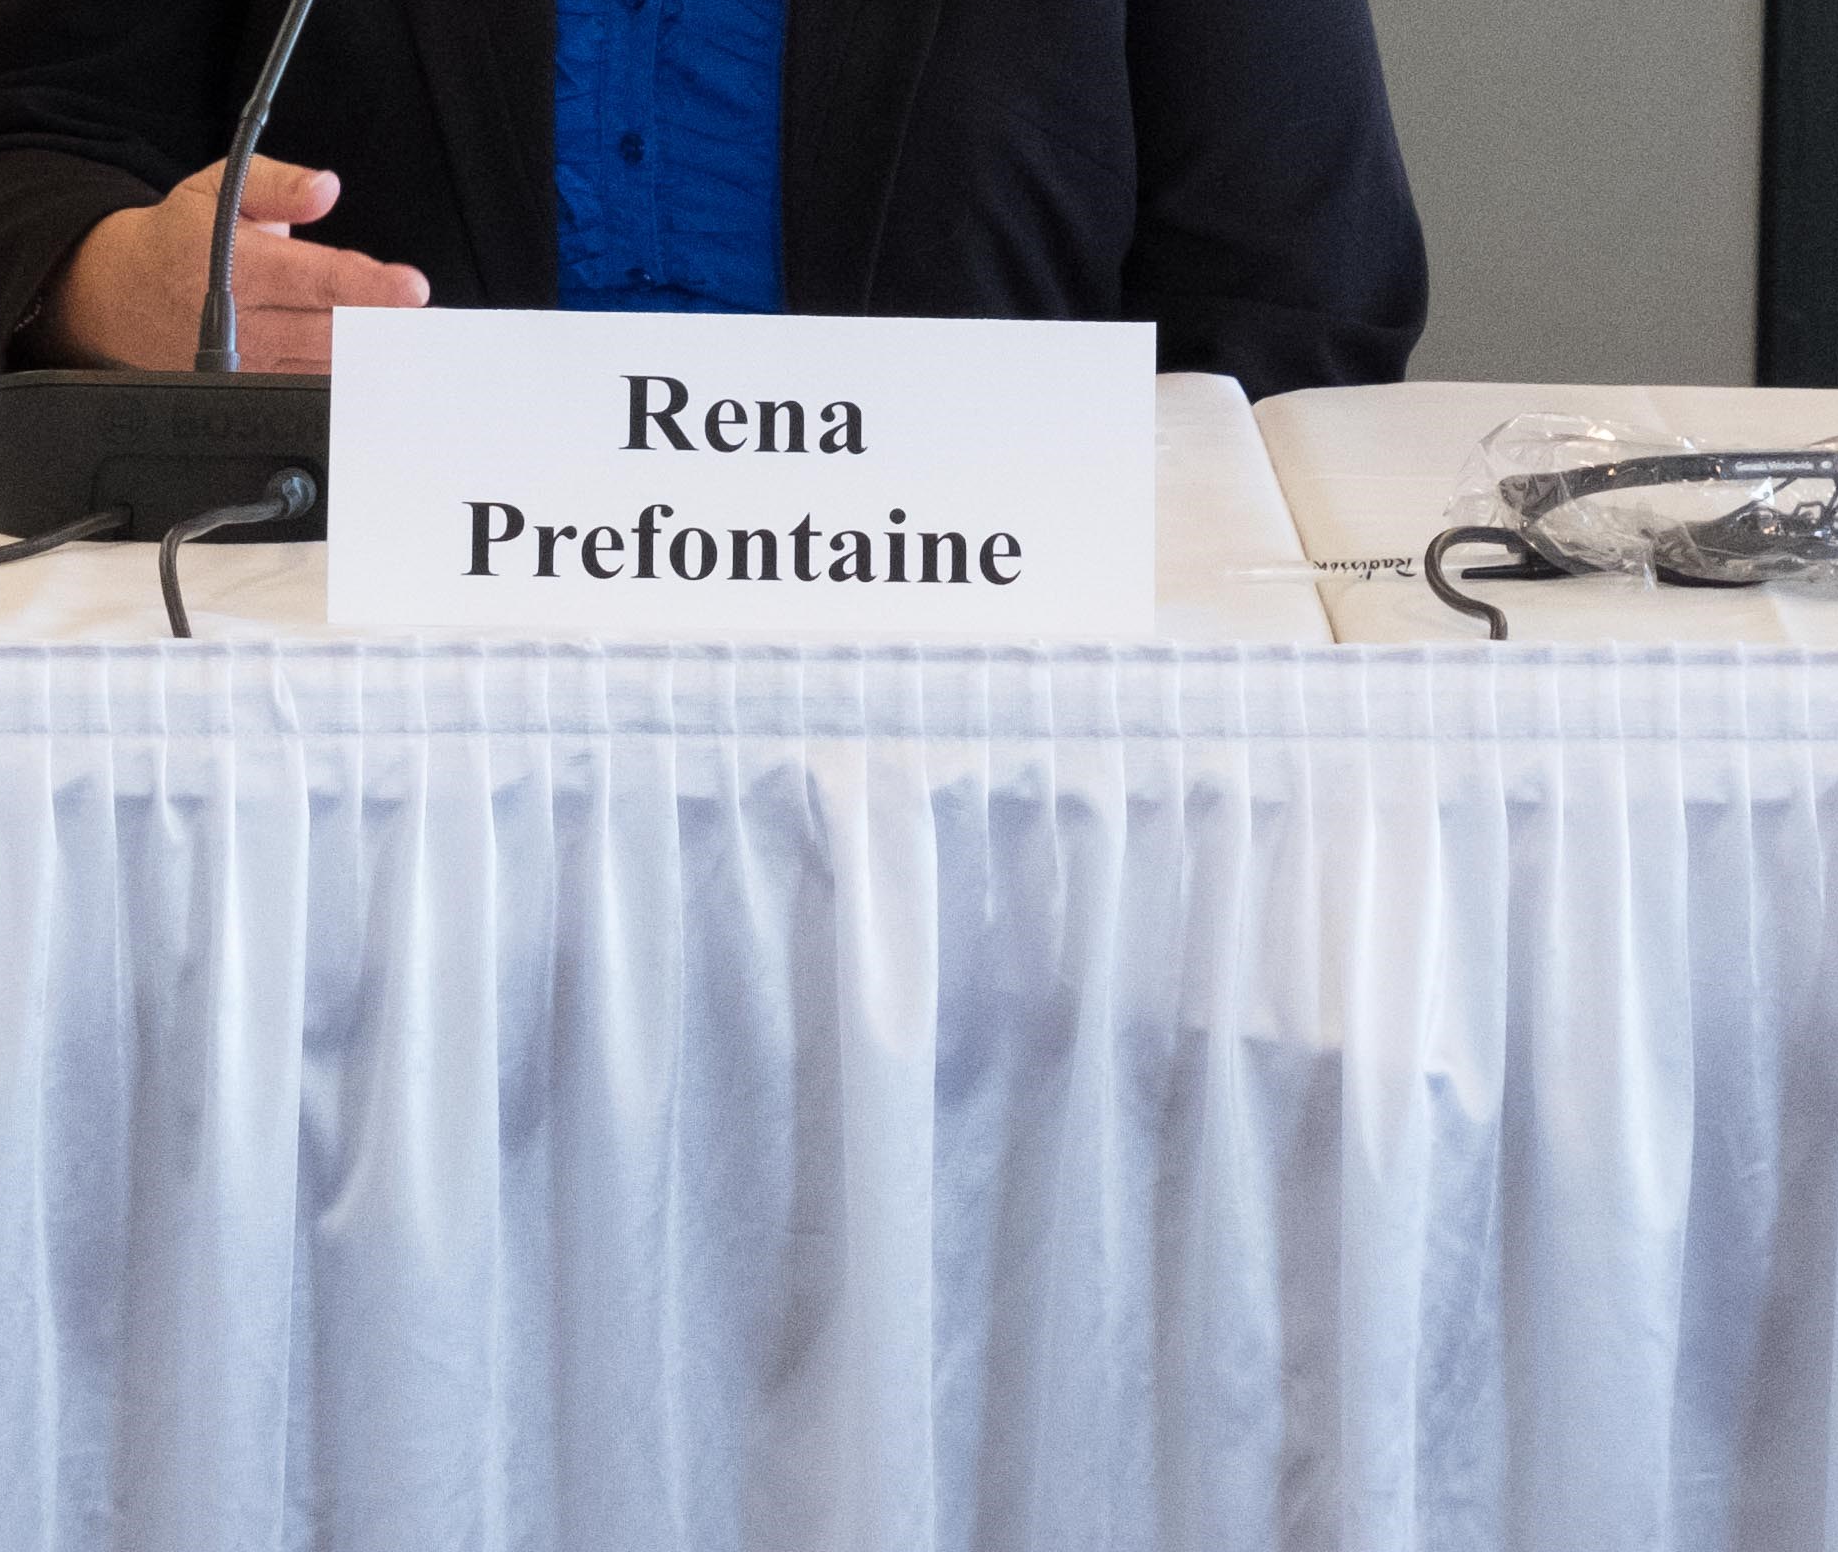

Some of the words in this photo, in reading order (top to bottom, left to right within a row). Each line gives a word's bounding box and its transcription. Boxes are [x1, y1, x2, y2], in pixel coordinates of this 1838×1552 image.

[619, 376, 867, 454] Rena
[463, 502, 1021, 585] Prefontaine
[1313, 557, 1417, 580] Radisson
